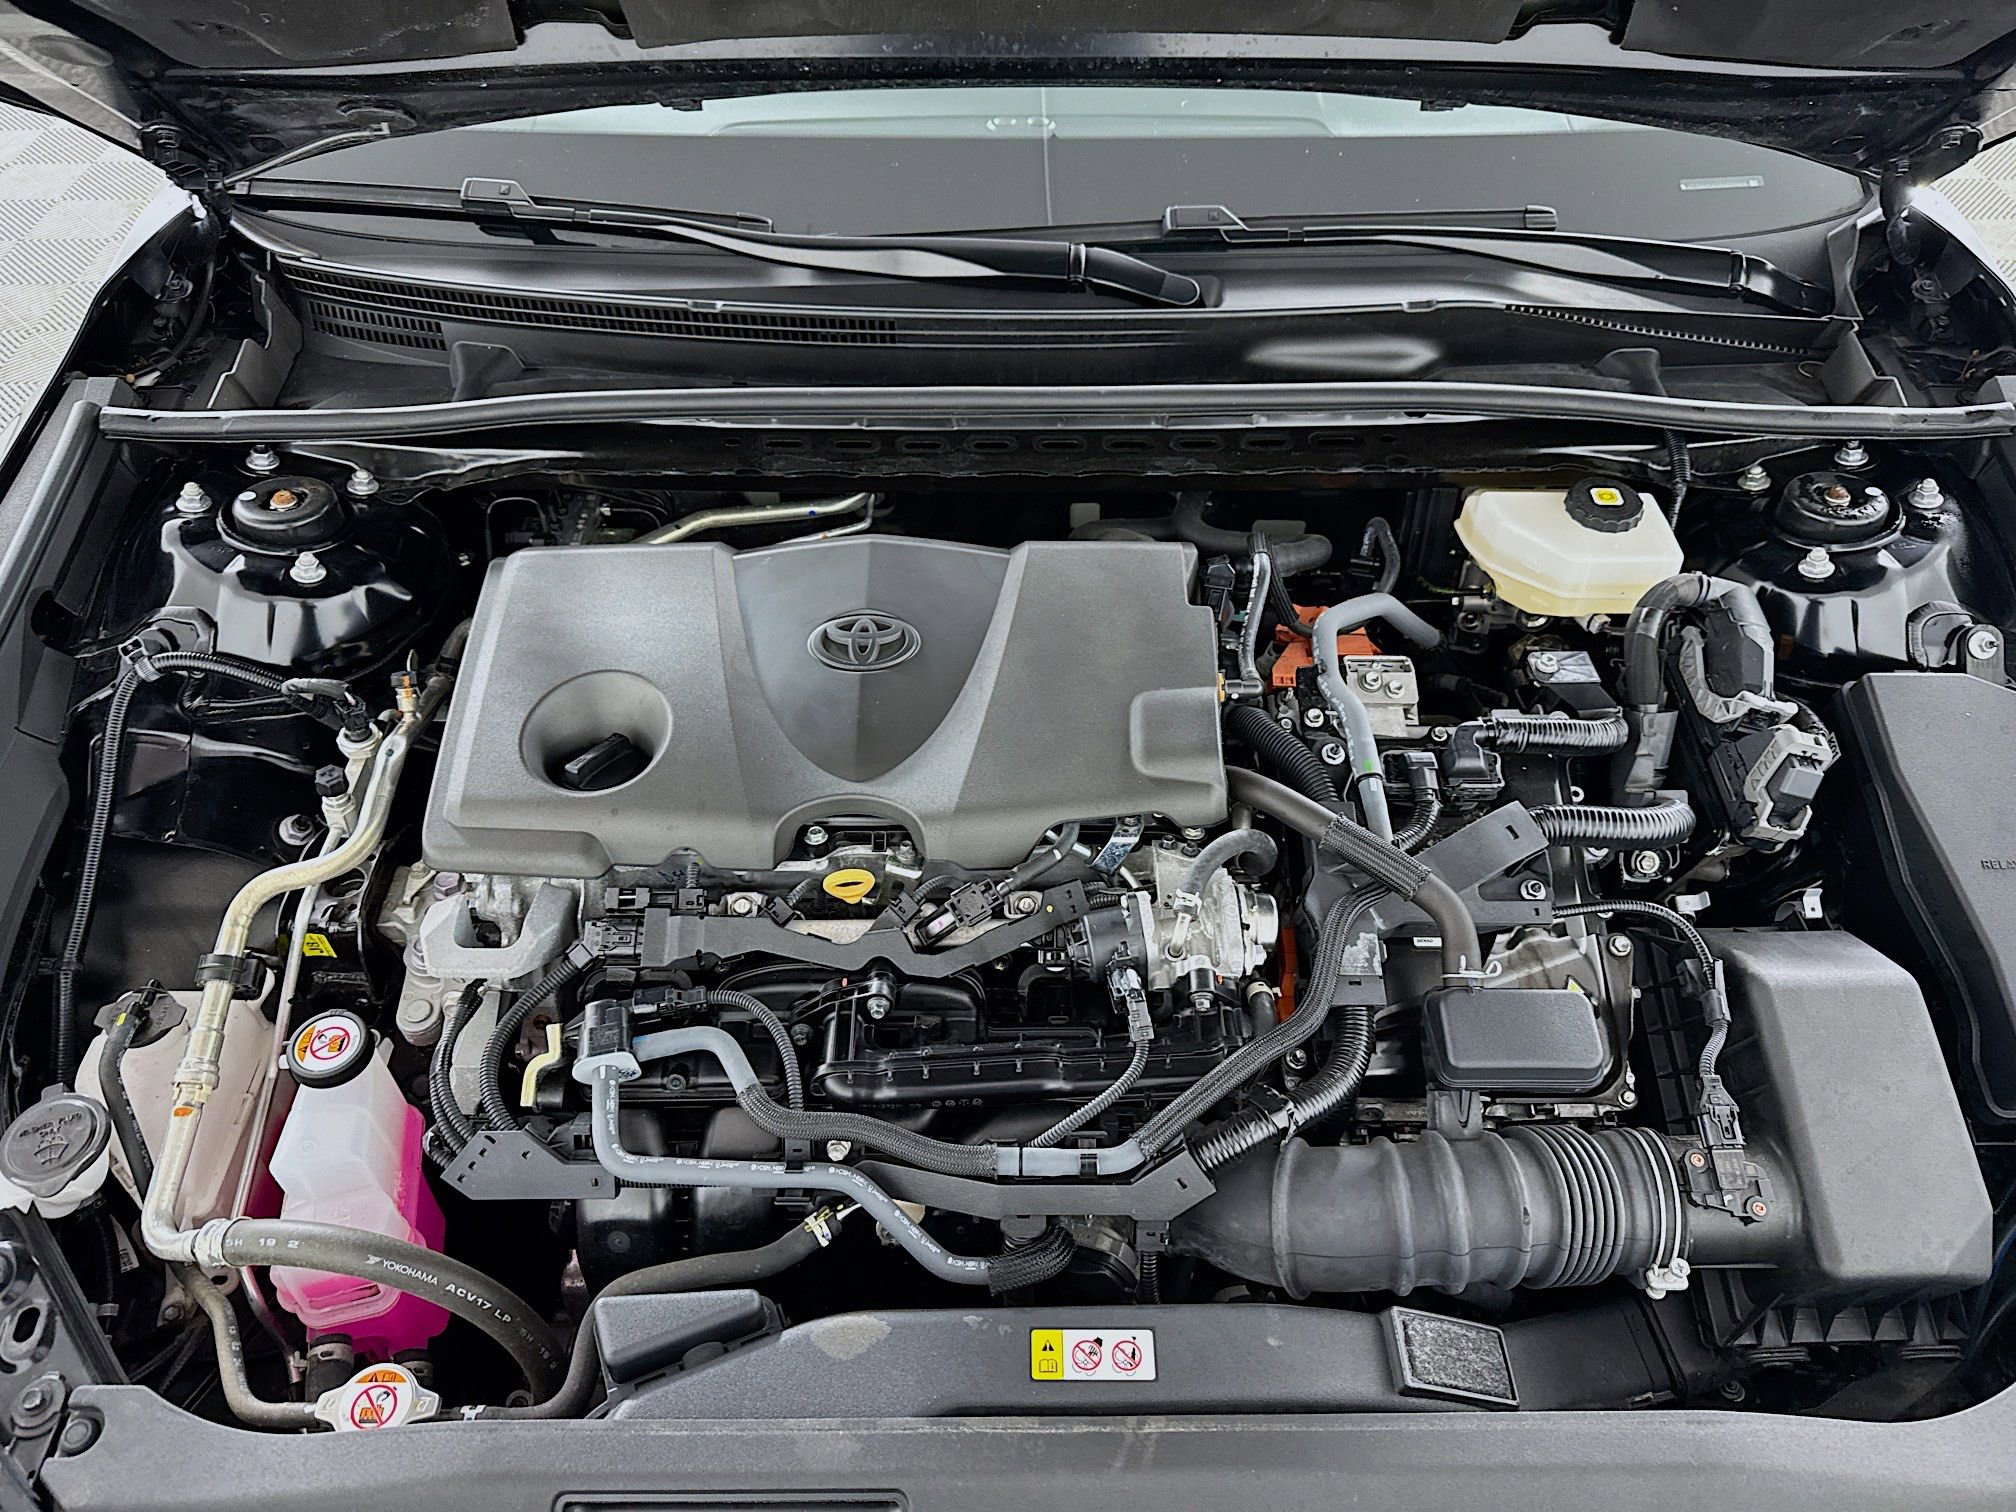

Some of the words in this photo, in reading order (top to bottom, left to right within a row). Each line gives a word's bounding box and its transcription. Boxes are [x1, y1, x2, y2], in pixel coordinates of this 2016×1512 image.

[382, 1259, 439, 1286] YOKOHAMA
[445, 1283, 493, 1311] ACV17
[494, 1308, 512, 1324] LP
